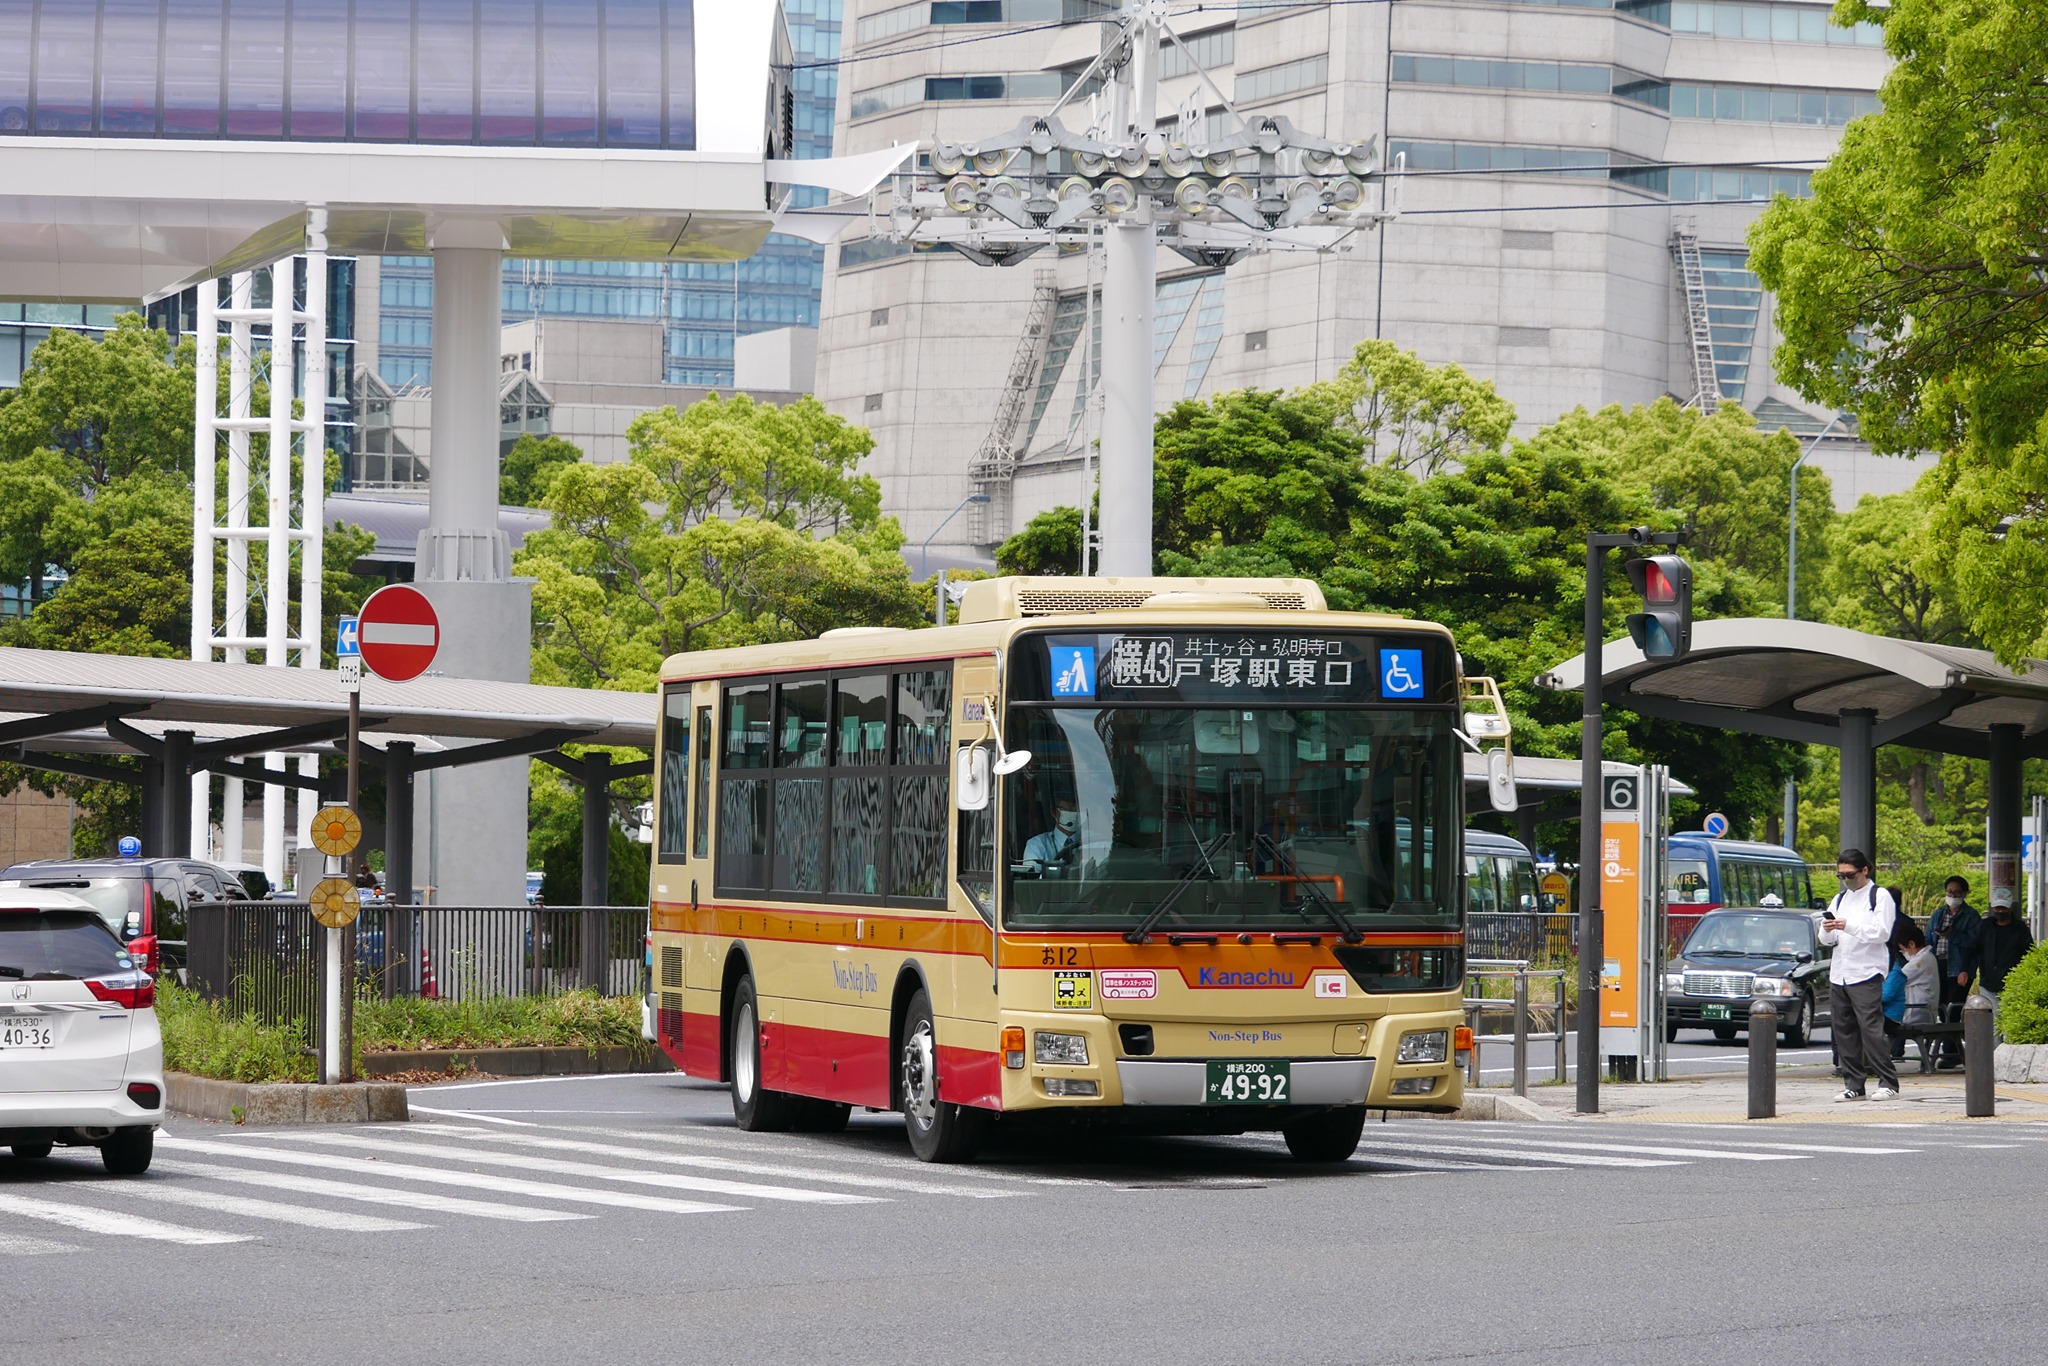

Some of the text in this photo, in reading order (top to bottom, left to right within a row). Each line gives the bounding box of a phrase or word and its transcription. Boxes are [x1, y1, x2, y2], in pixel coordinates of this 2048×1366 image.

[1184, 638, 1342, 657] 井土ヶ谷・弘明寺口
[1114, 640, 1172, 684] 横43
[340, 665, 358, 684] ここから
[1172, 657, 1352, 687] 戸塚駅東口
[1610, 778, 1633, 808] 6
[1608, 865, 1616, 873] N
[1041, 946, 1078, 966] お12
[833, 960, 878, 999] Non-Step Bus
[1058, 971, 1086, 979] あぶない
[1199, 967, 1294, 986] Kanachu
[4, 1017, 39, 1027] 横浜530
[1720, 1010, 1730, 1019] 14
[4, 1029, 51, 1046] 40-36
[1208, 1030, 1282, 1044] Non-Step Bus
[1226, 1063, 1266, 1074] 横浜200
[1210, 1074, 1287, 1100] か 49-92
